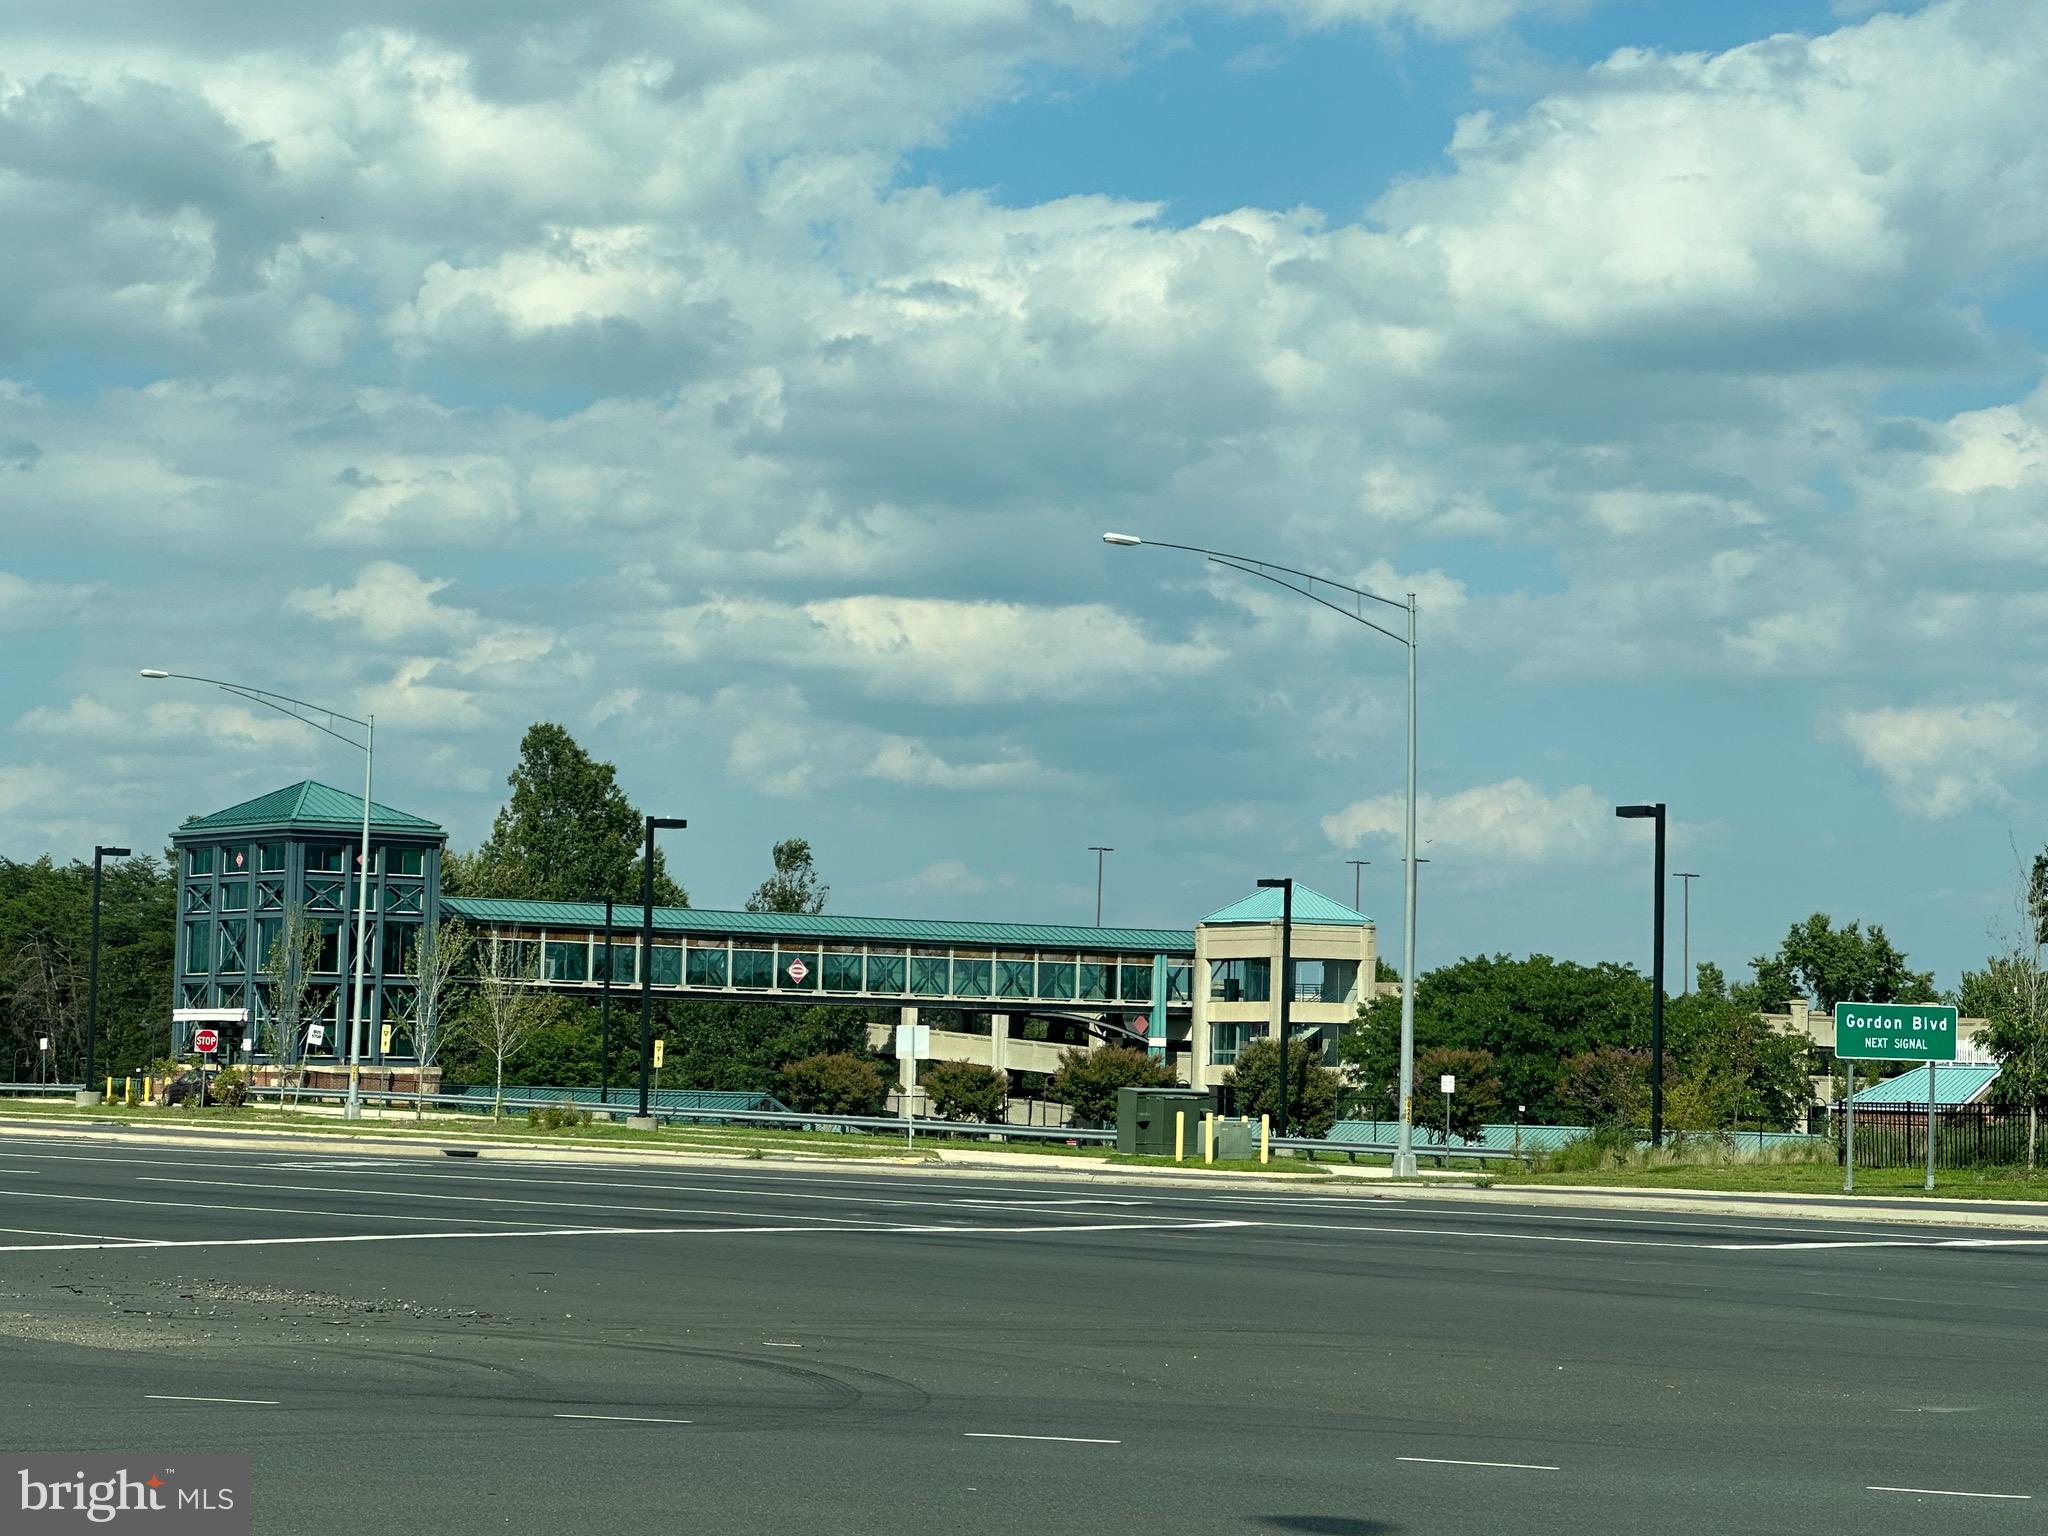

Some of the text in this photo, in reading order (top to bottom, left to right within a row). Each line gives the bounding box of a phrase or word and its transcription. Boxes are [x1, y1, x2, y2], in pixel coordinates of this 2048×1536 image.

[1846, 1014, 1947, 1031] Gordon Blvd
[196, 1037, 216, 1045] STOP
[1865, 1038, 1928, 1050] NEXT SIGNAL
